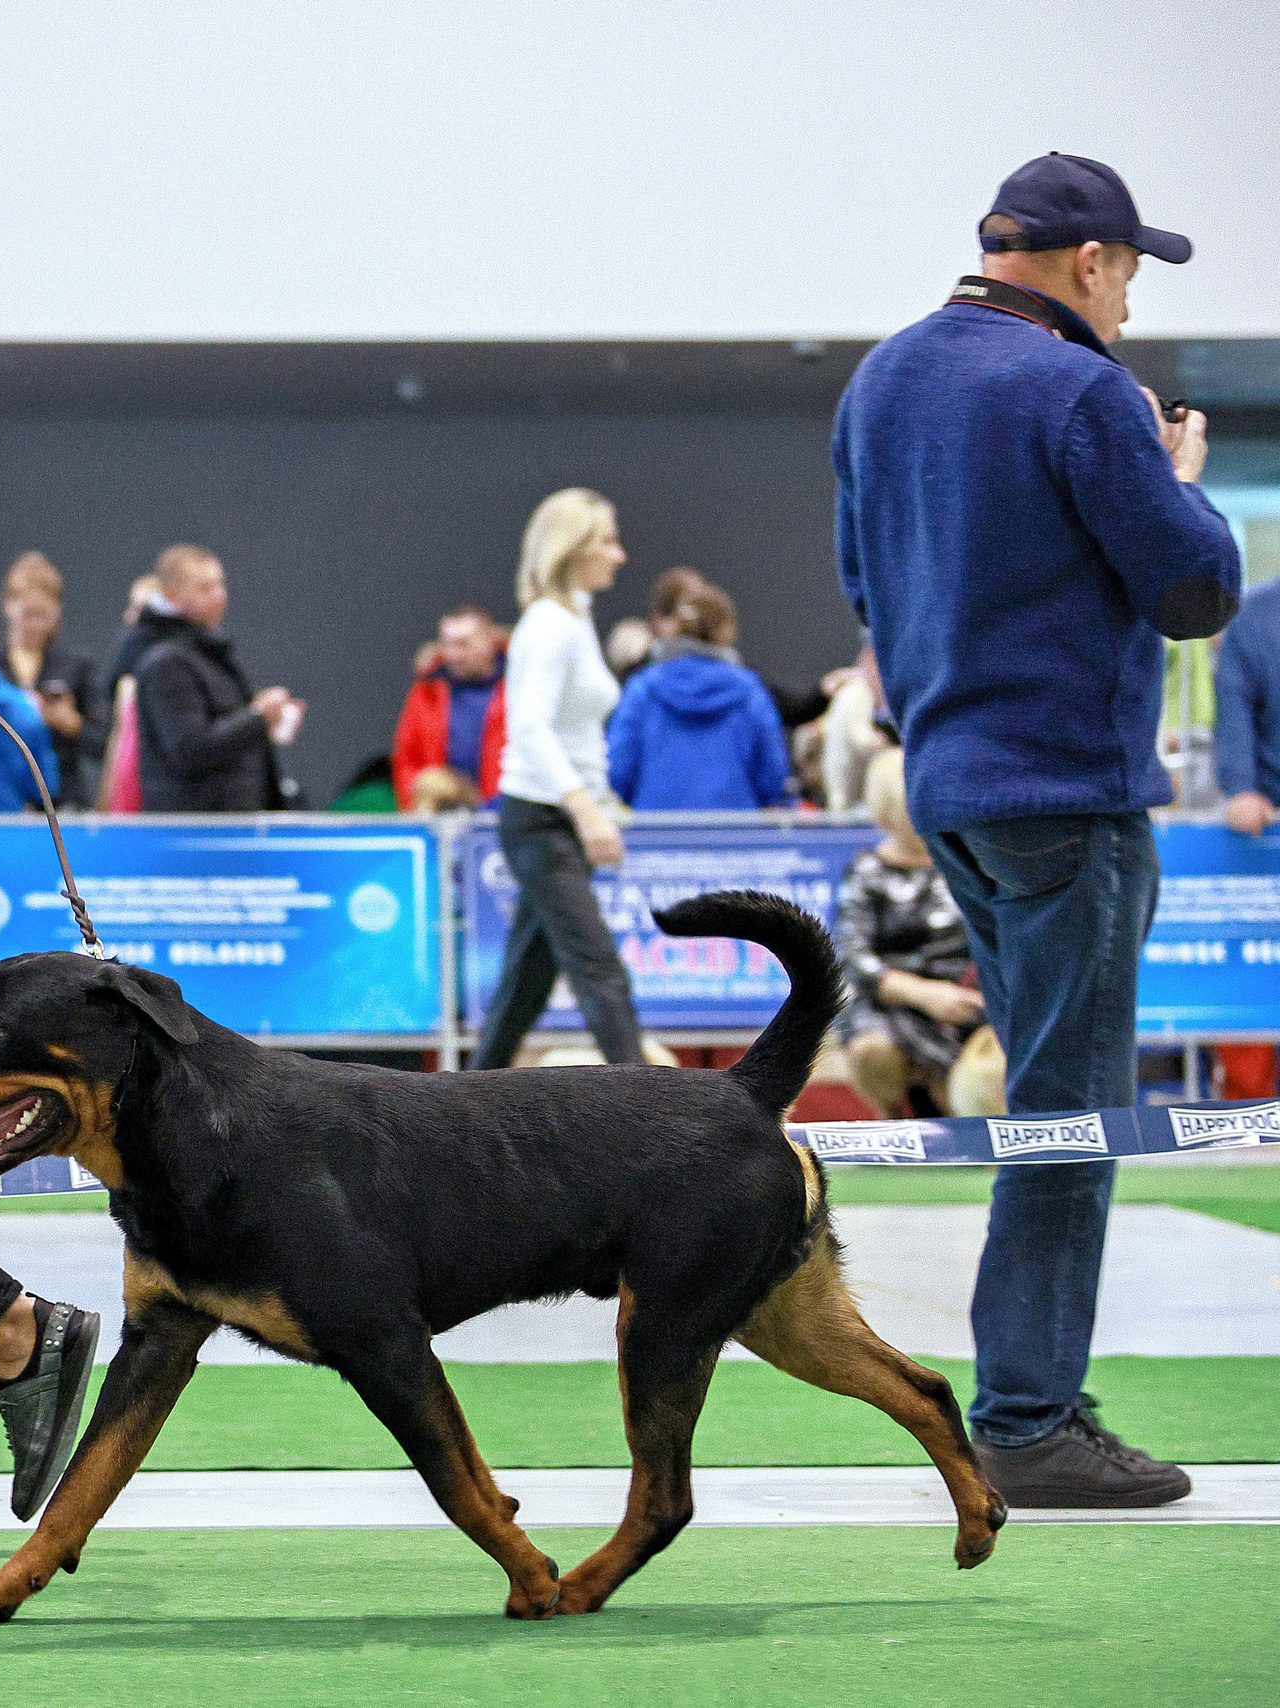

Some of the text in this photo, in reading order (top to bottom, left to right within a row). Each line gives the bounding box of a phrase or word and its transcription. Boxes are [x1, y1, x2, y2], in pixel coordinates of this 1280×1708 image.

[997, 1123, 1098, 1148] HAPPY DOG
[1179, 1112, 1280, 1137] HAPPY DOG
[814, 1131, 916, 1150] HAPPY DOG
